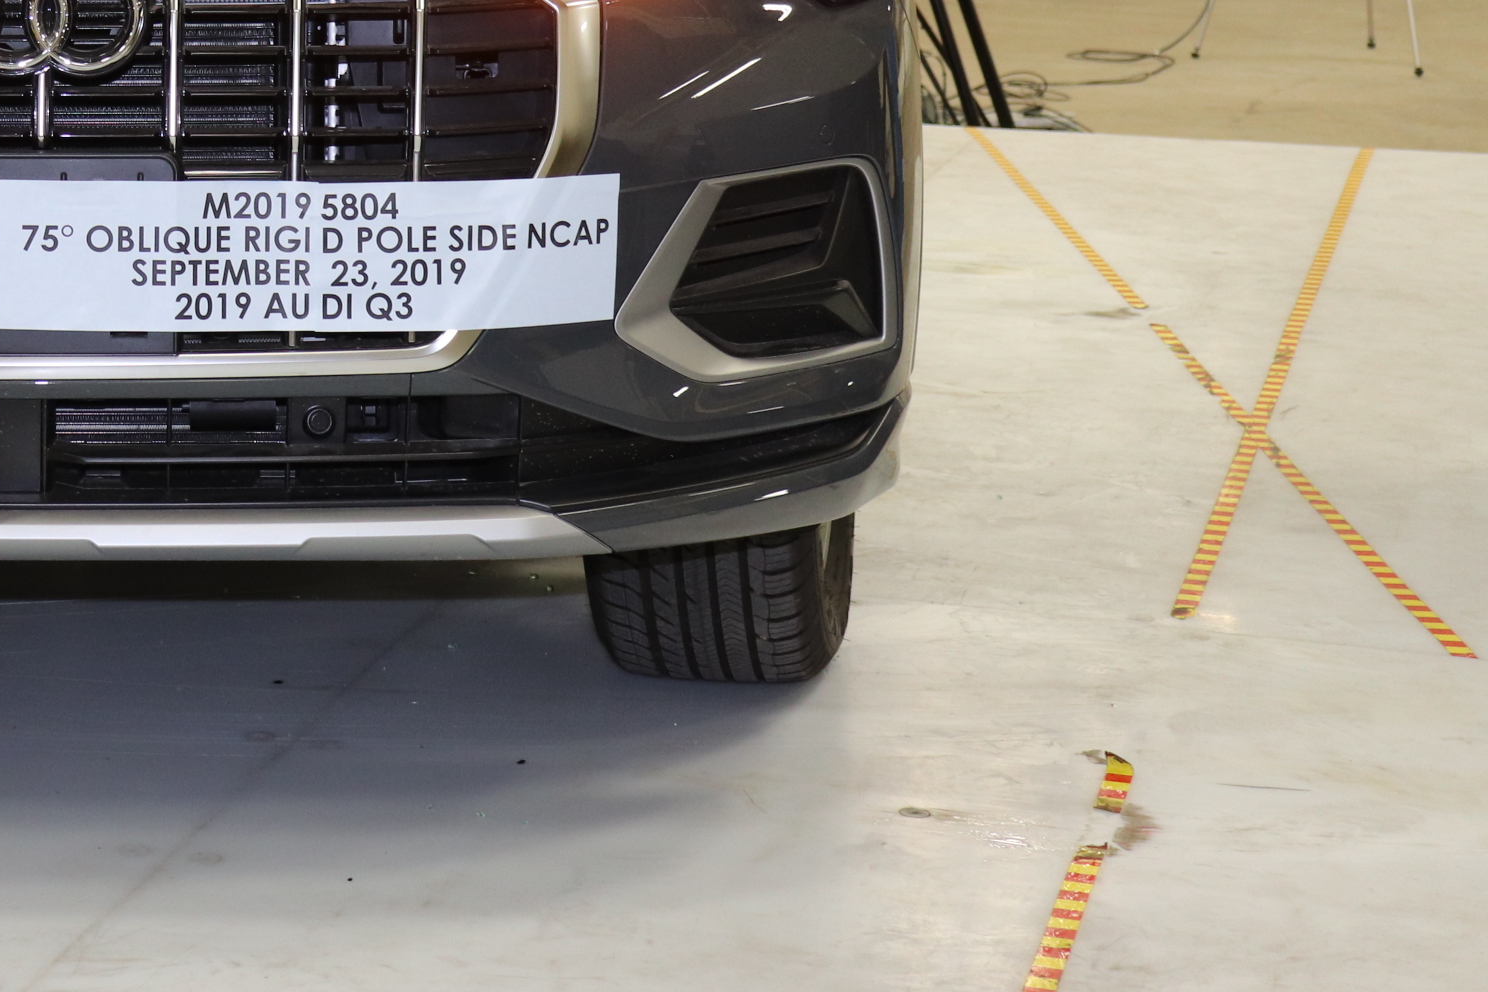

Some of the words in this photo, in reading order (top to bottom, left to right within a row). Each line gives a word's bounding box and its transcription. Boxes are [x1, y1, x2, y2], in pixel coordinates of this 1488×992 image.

[86, 224, 232, 255] OBLIQUE
[357, 224, 438, 254] POLE
[448, 223, 517, 253] SIDE
[527, 217, 610, 250] NCAP
[131, 258, 311, 288] SEPTEMBER
[330, 259, 378, 290] 23,
[390, 257, 468, 287] 2019
[174, 292, 252, 321] 2019
[365, 292, 414, 322] Q3
